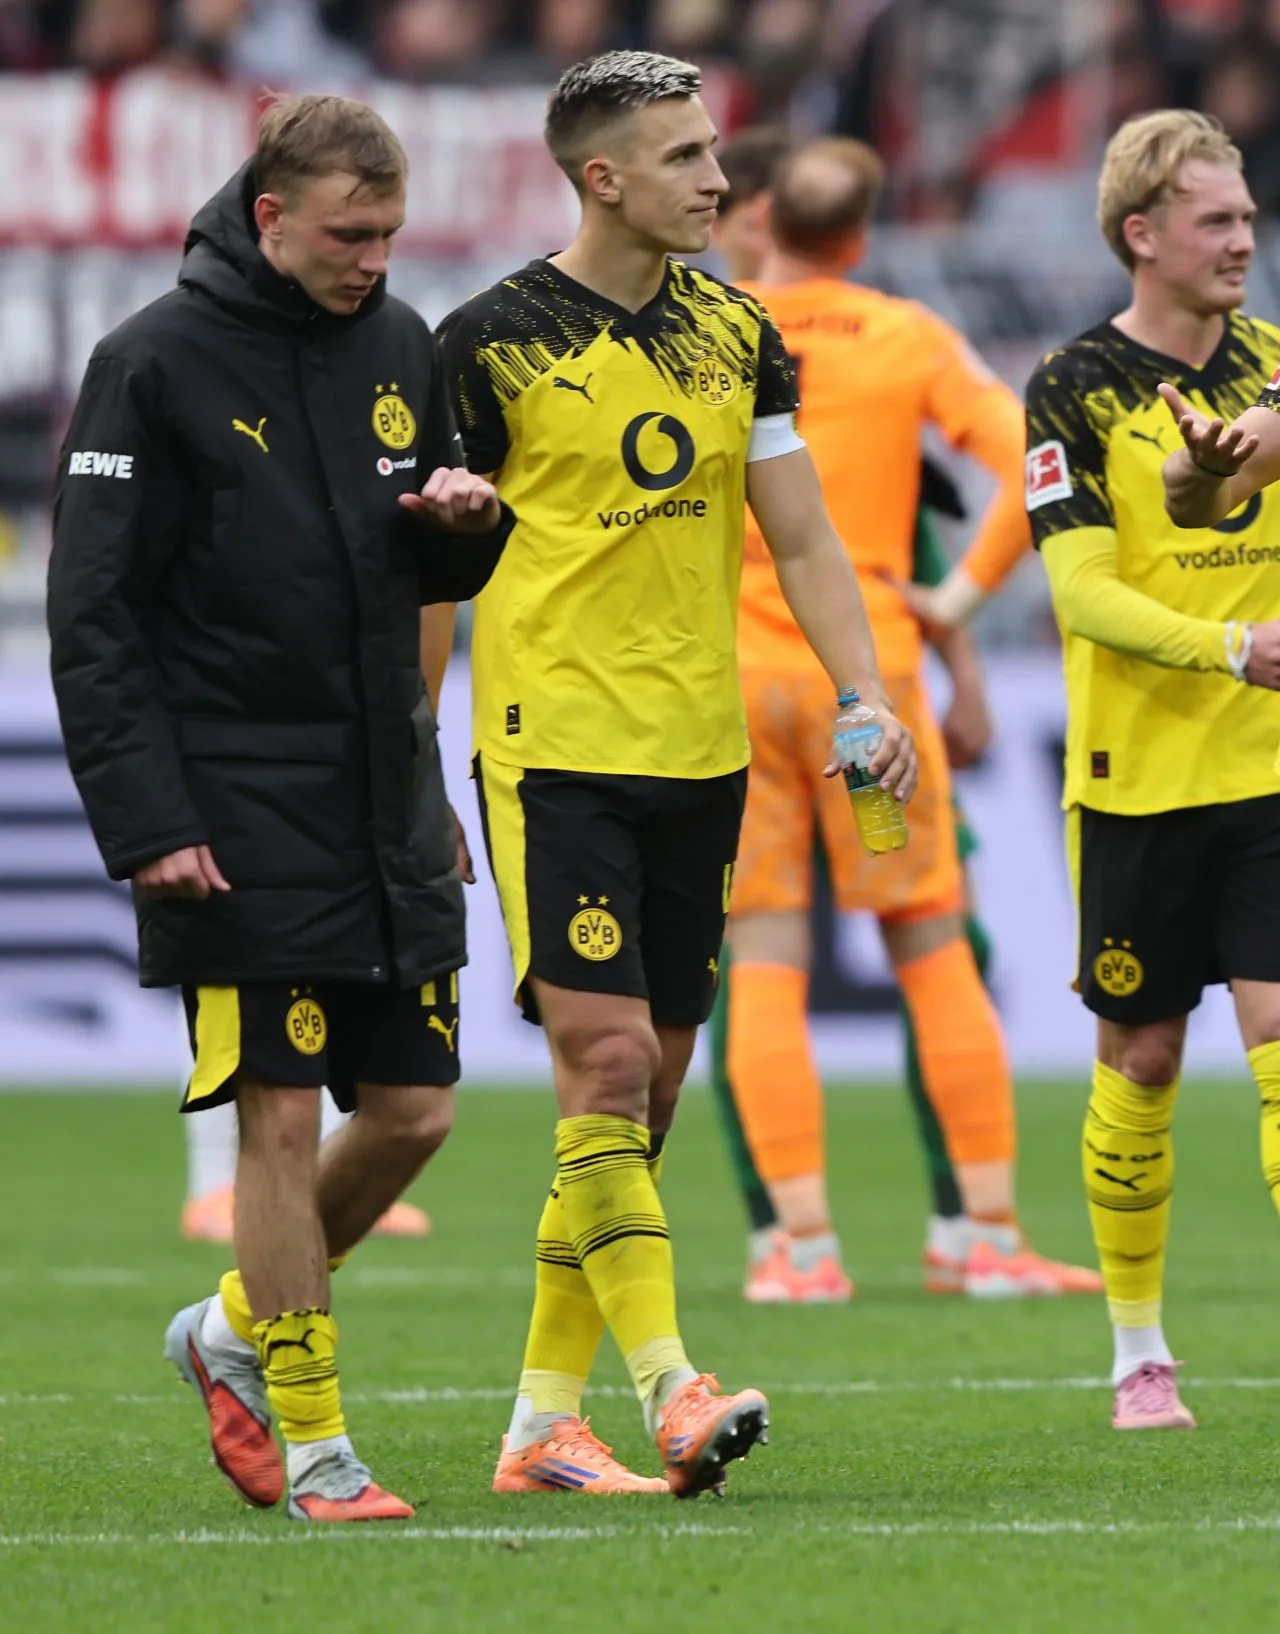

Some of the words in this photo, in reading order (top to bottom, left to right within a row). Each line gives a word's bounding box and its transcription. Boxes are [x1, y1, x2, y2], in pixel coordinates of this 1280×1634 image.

[699, 362, 731, 392] BVB
[378, 401, 408, 433] BVB
[68, 451, 134, 479] REWE
[597, 499, 706, 529] vodone
[577, 914, 615, 945] BVB
[1101, 954, 1136, 983] BVB
[293, 1005, 322, 1040] BVB
